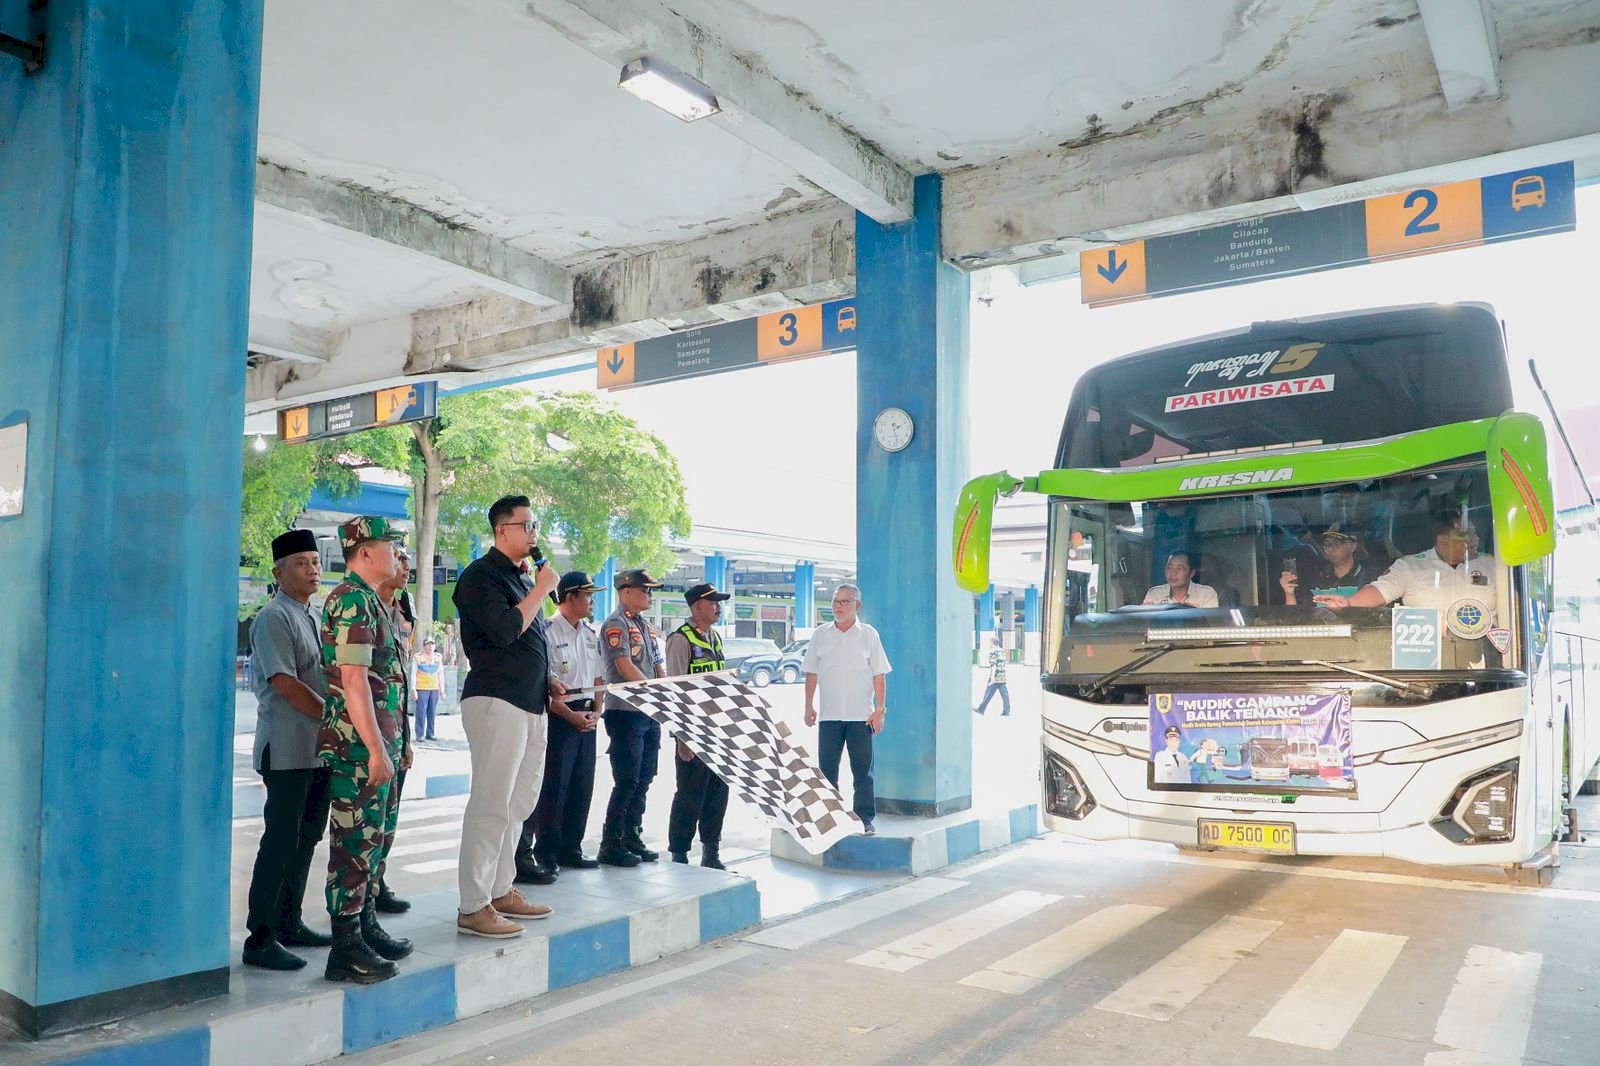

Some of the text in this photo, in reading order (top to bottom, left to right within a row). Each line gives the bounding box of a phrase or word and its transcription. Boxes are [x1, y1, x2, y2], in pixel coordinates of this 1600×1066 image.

[1403, 189, 1440, 237] 2
[1233, 227, 1269, 239] Cilacap
[1230, 237, 1273, 250] Bandung
[1214, 245, 1290, 263] Jakarta/Banten
[1229, 258, 1275, 271] Sumatera
[686, 329, 702, 338] Solo
[778, 313, 798, 347] 3
[677, 347, 711, 359] Semarang
[1270, 342, 1327, 374] 5
[677, 356, 710, 368] Pemalang
[1171, 377, 1326, 410] PARIWISATA
[1179, 467, 1294, 491] KRESNA
[1396, 624, 1435, 646] 222
[1235, 695, 1318, 709] GAMPANG
[1186, 709, 1231, 722] BALIK
[1202, 825, 1219, 840] AD
[1228, 826, 1263, 842] 7500
